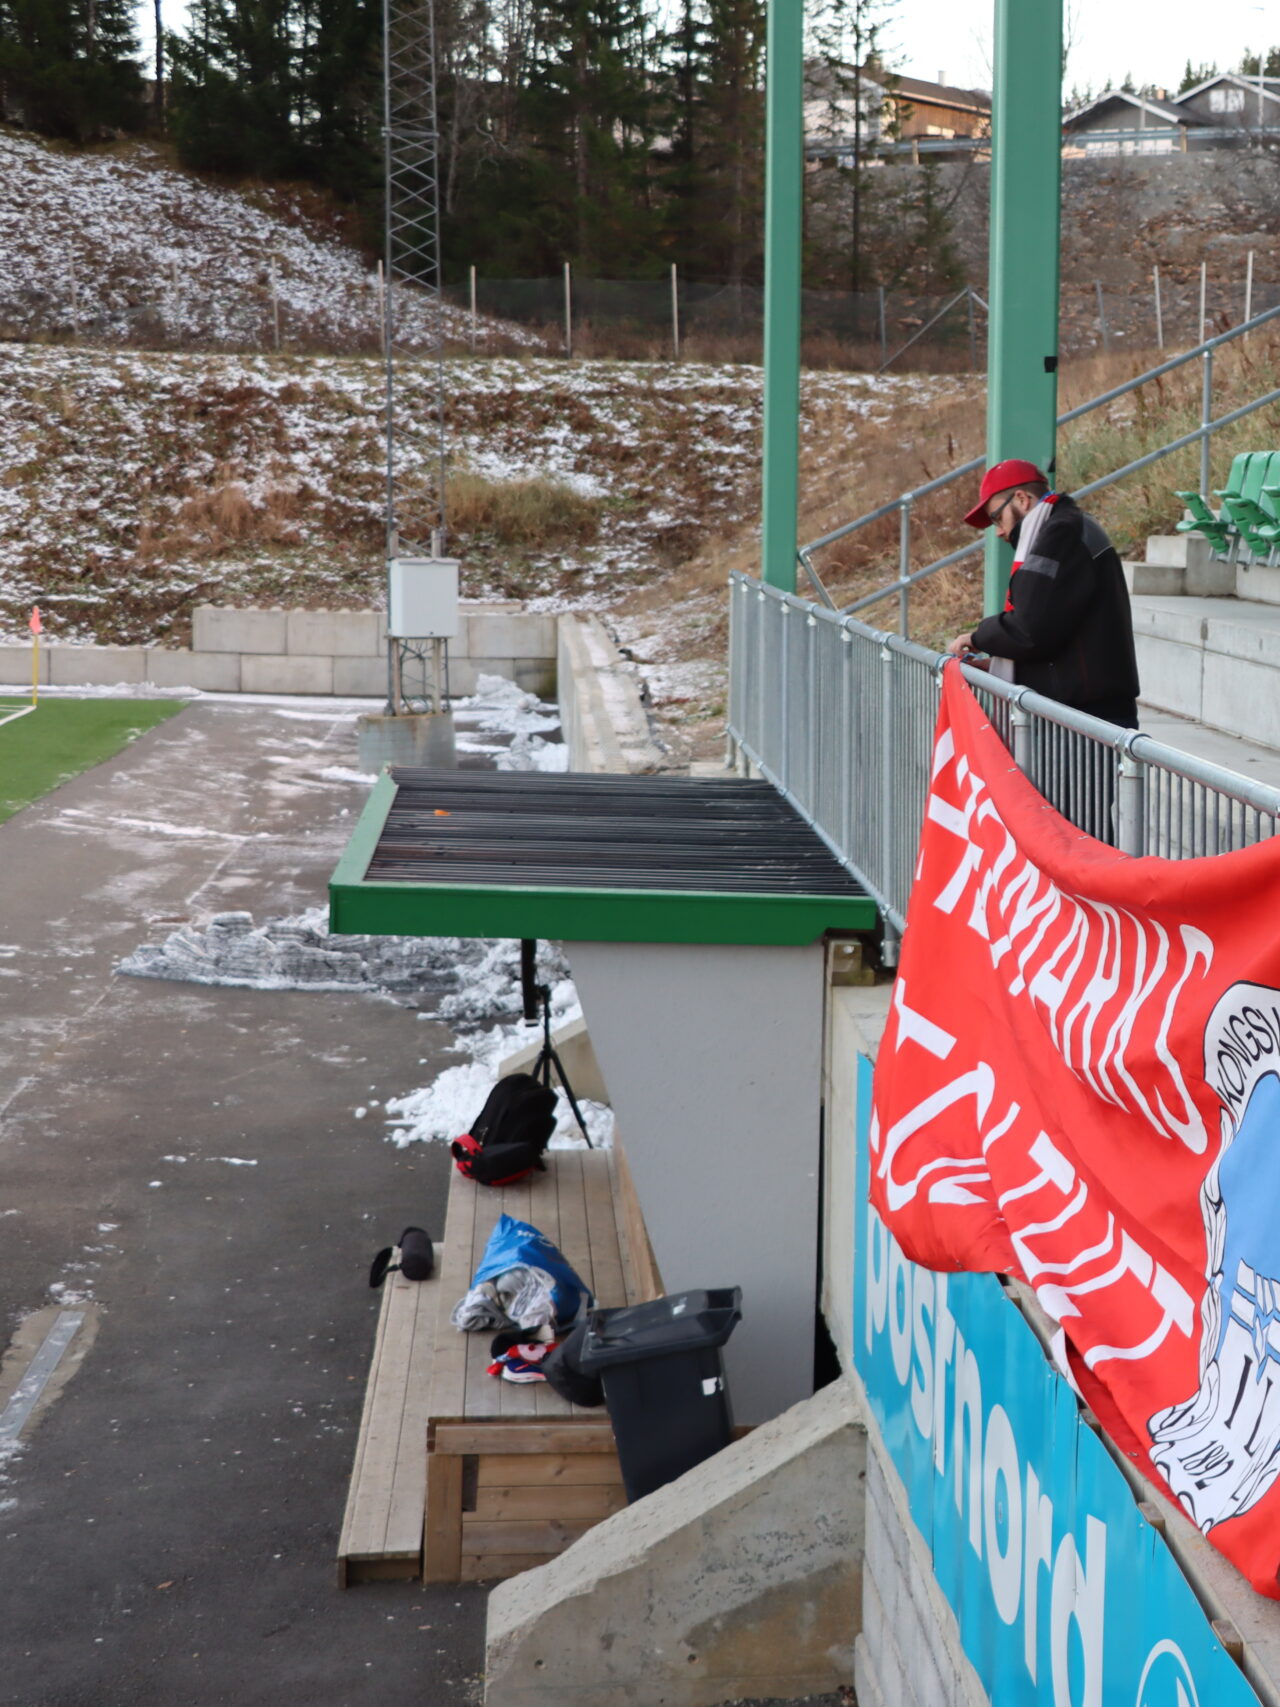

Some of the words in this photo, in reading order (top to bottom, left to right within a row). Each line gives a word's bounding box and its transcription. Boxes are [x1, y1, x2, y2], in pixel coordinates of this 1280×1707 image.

[915, 728, 1214, 1154] HDMARKS
[866, 1207, 1107, 1707] postnord
[1177, 1440, 1234, 1490] 1892
